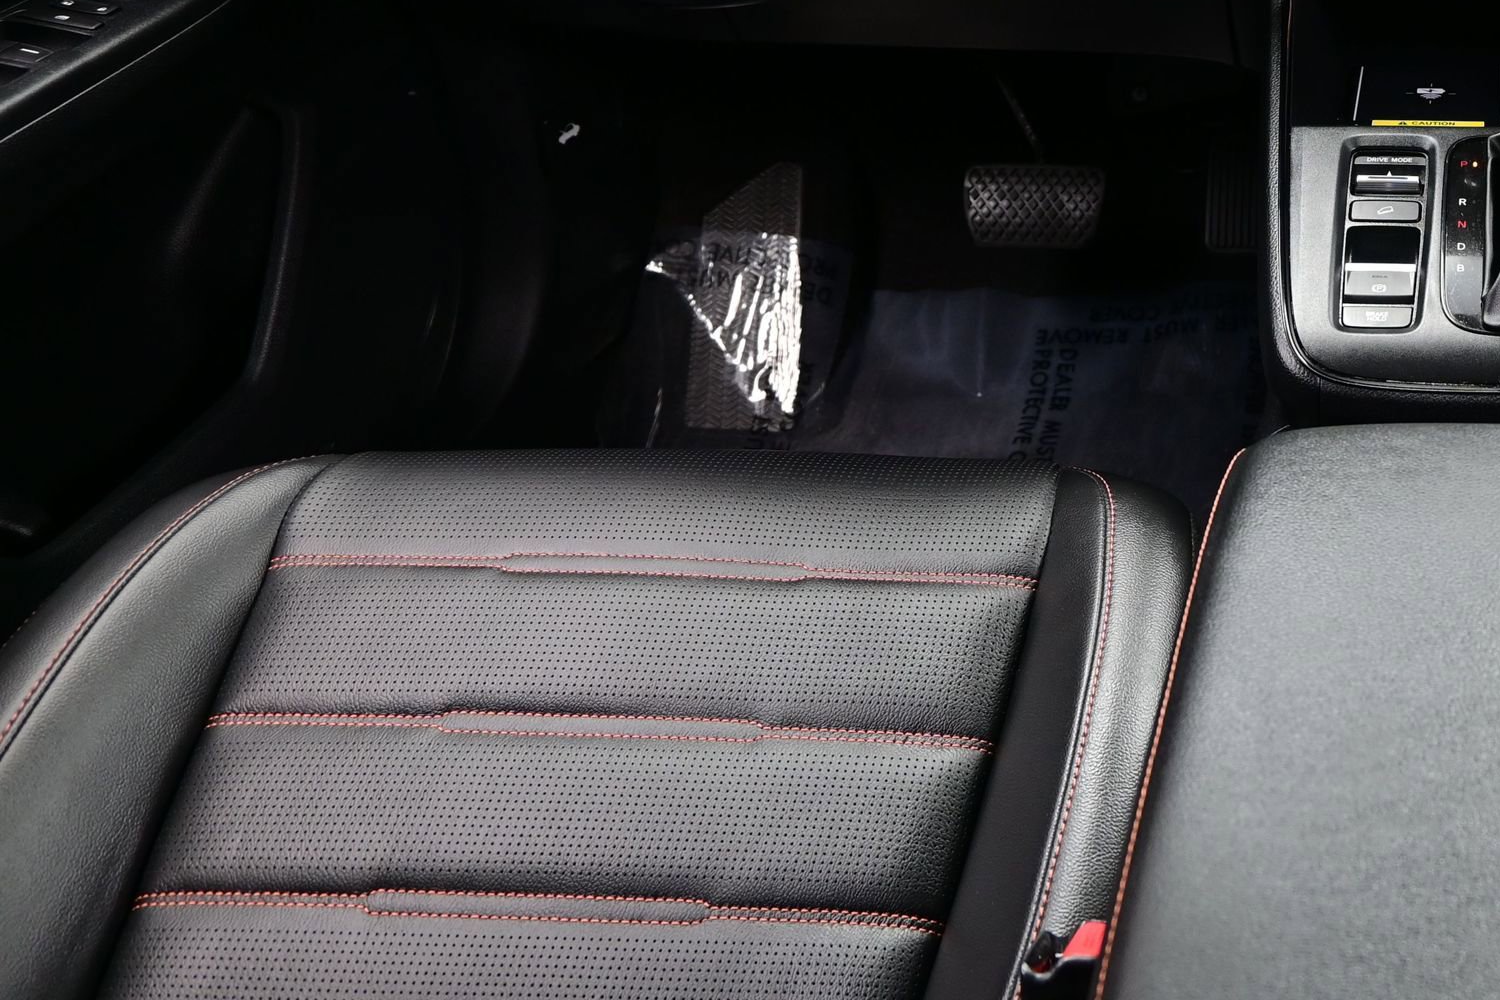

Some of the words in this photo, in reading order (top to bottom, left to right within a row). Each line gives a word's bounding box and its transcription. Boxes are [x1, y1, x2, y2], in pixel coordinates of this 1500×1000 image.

[1458, 198, 1467, 206] R
[1456, 264, 1464, 272] B
[1036, 328, 1128, 345] REMOVE
[1049, 348, 1079, 412] DEALER
[1013, 349, 1054, 446] PROTECTIVE
